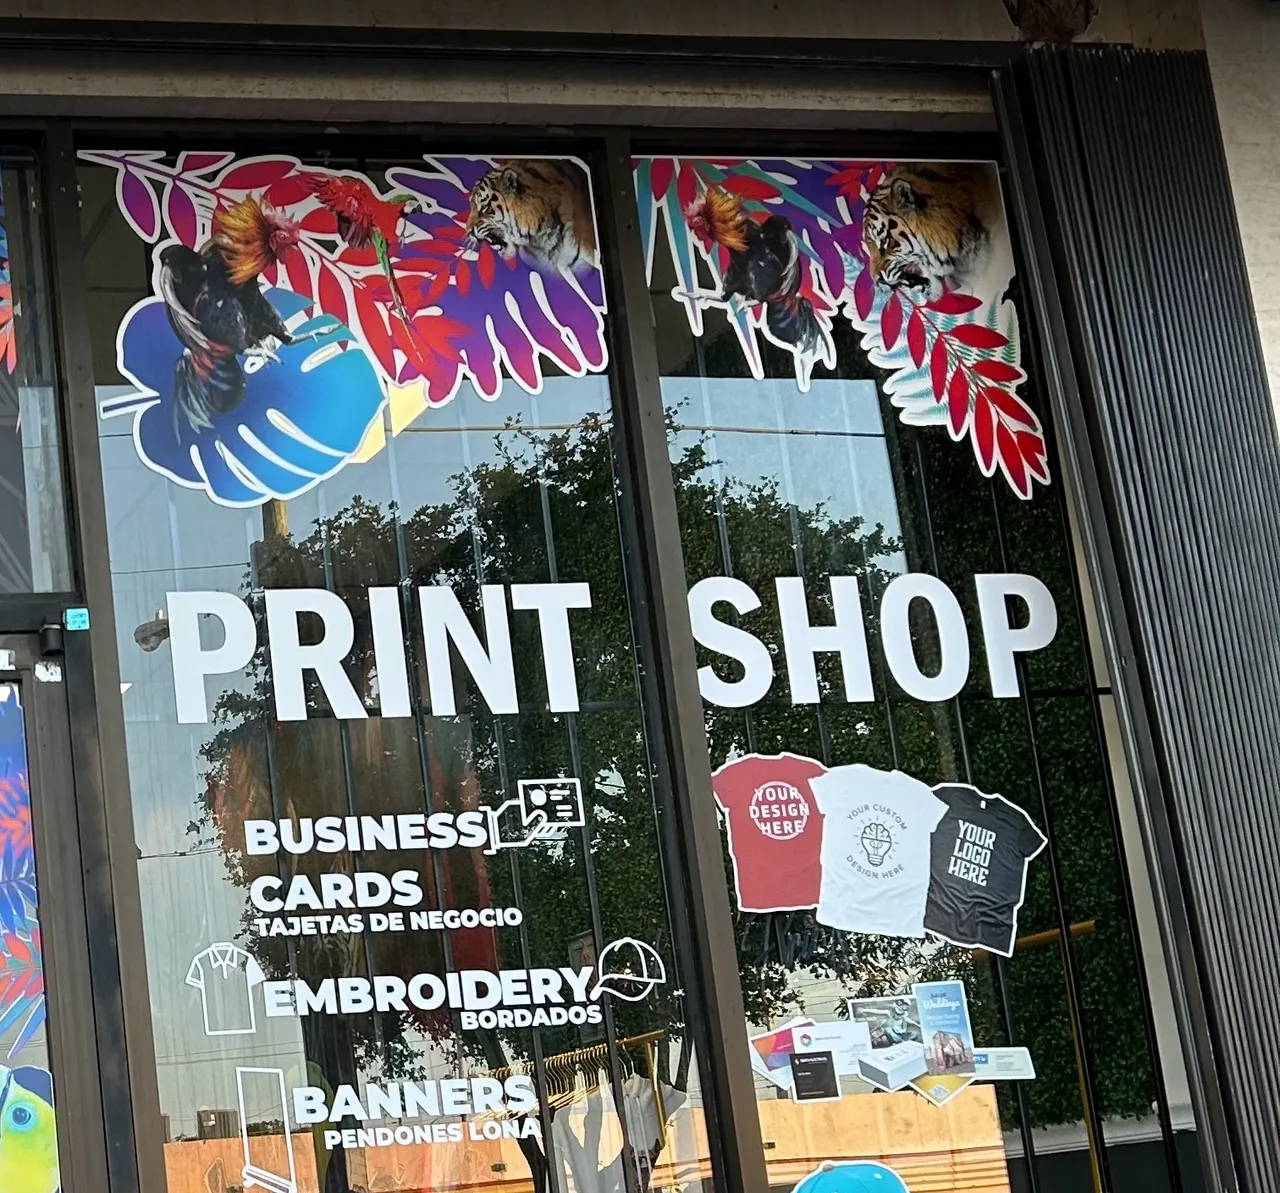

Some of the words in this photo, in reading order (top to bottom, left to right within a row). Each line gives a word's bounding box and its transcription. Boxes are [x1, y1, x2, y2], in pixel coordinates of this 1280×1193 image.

[166, 582, 592, 724] PRINT
[687, 572, 1058, 707] SHOP
[754, 787, 800, 801] YOUR
[749, 803, 810, 819] DESIGN
[847, 804, 870, 820] YOUR
[873, 804, 908, 831] CUSTOM
[244, 811, 486, 855] BUSINESS
[761, 820, 804, 835] HERE
[958, 819, 997, 850] YOUR
[846, 855, 879, 879] DESIGN
[882, 864, 904, 879] HERE
[953, 838, 991, 867] LOGO
[948, 856, 989, 887] HERE
[250, 870, 423, 913] CARDS
[255, 914, 364, 938] TAJETAS
[370, 911, 404, 933] DE
[410, 907, 523, 931] NEGOCIO
[263, 965, 595, 1017] EMBROIDERY
[461, 1004, 602, 1031] BORDADOS
[293, 1075, 537, 1125] BANNERS
[324, 1122, 464, 1150] PENDONES
[469, 1118, 543, 1142] LONA
